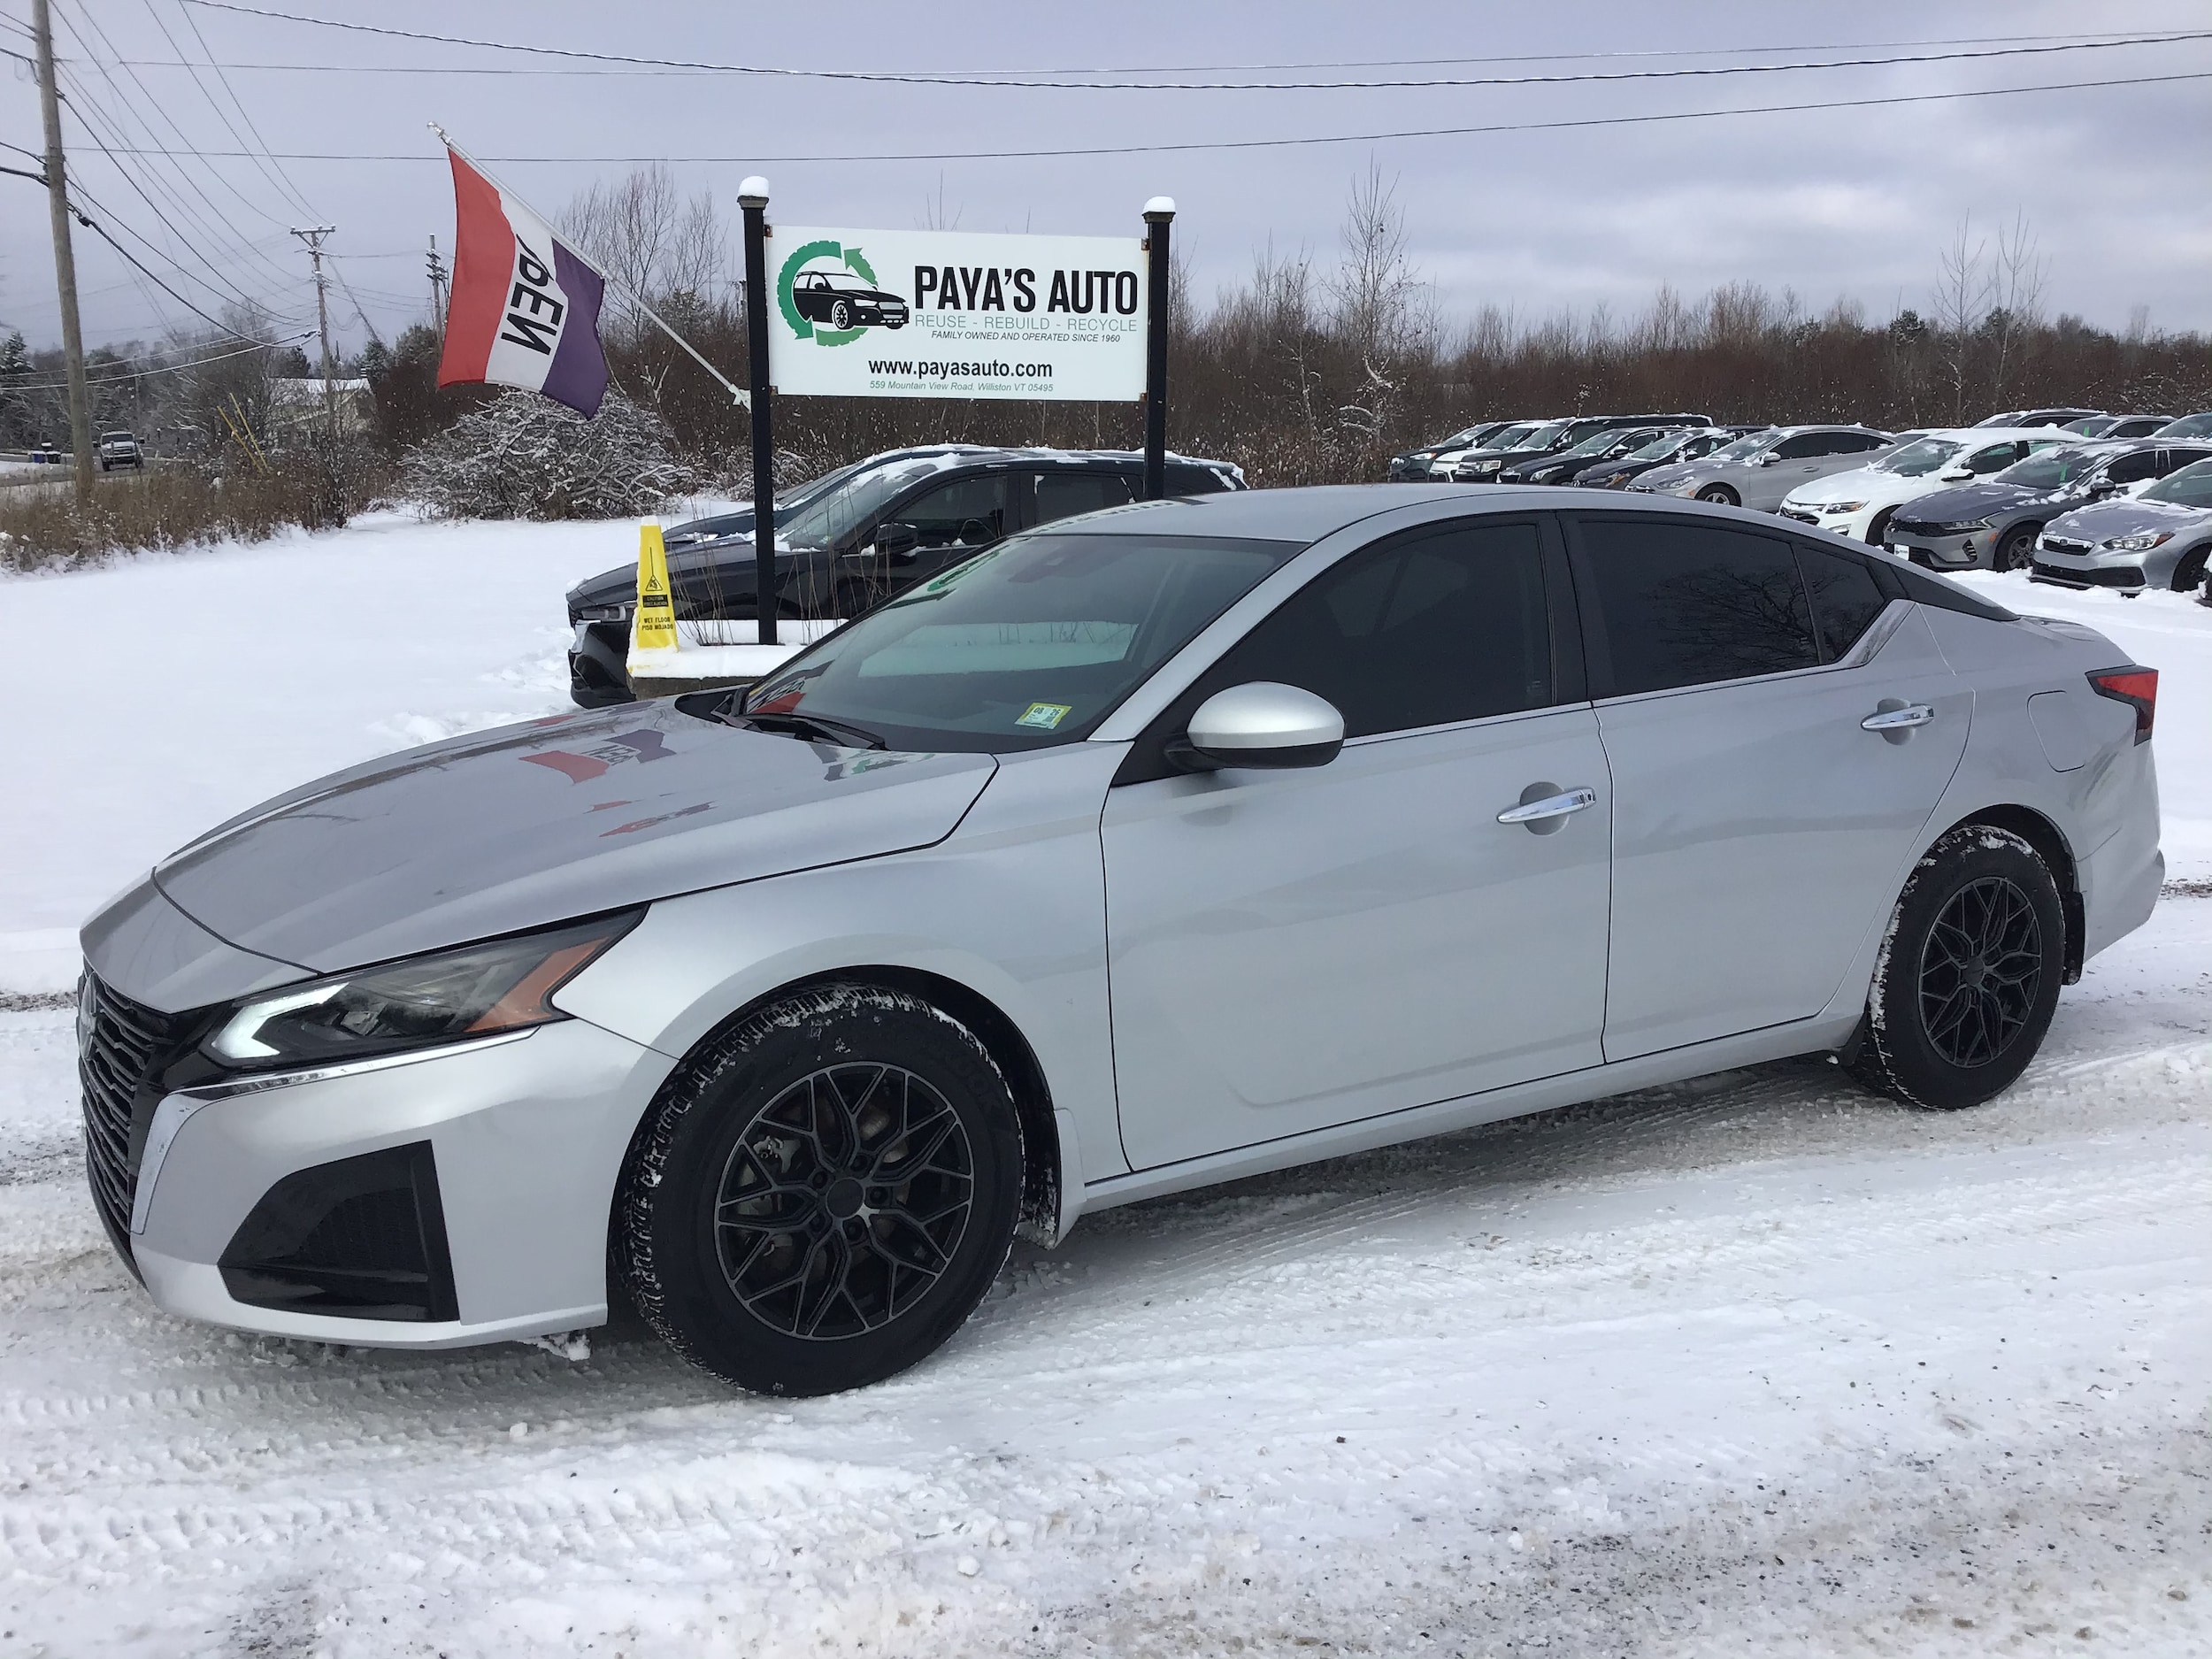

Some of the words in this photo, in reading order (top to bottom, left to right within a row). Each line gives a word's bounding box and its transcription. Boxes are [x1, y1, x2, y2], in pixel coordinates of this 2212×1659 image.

[915, 265, 1036, 313] PAYA'S
[1048, 270, 1138, 315] AUTO
[915, 314, 966, 328] REUSE
[984, 316, 1050, 330] REBUILD
[1067, 318, 1137, 332] RECYCLE
[931, 330, 963, 339] FAMILY
[964, 331, 999, 340] OWNED
[1000, 332, 1020, 341] AND
[1021, 333, 1070, 342] OPERATED
[1071, 334, 1098, 342] SINCE
[868, 359, 1053, 380] www.payasauto.com
[1027, 383, 1054, 392] 05495
